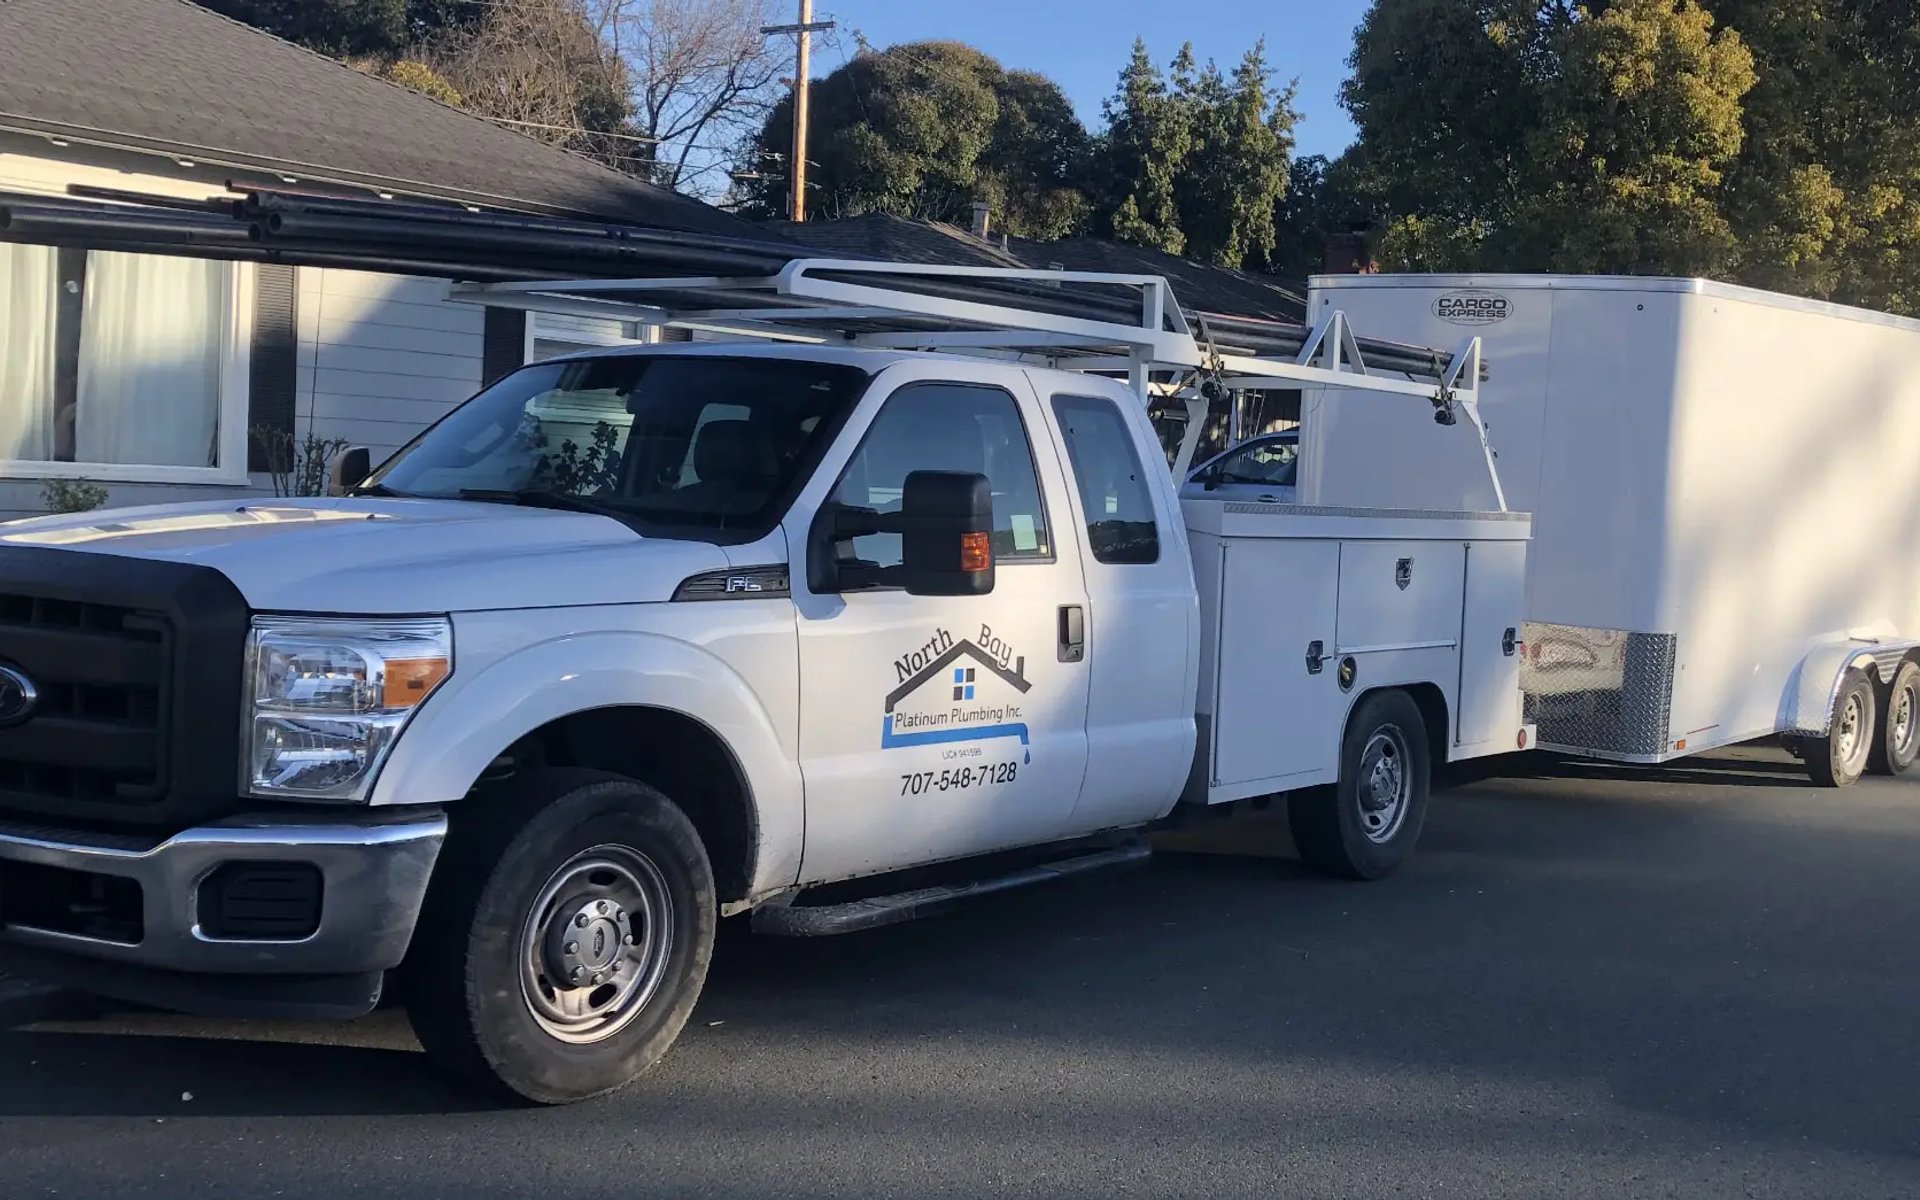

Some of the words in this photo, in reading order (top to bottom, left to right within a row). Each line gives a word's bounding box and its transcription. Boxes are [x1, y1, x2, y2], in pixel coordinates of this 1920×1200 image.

[1438, 298, 1507, 309] CARGO
[1438, 308, 1506, 318] EXPRESS
[893, 627, 954, 684] North
[976, 623, 1013, 669] Bay
[895, 711, 948, 728] Platinum
[951, 707, 1003, 724] Plumbing
[1005, 704, 1023, 718] Inc.
[900, 761, 1018, 797] 707-548-7128
